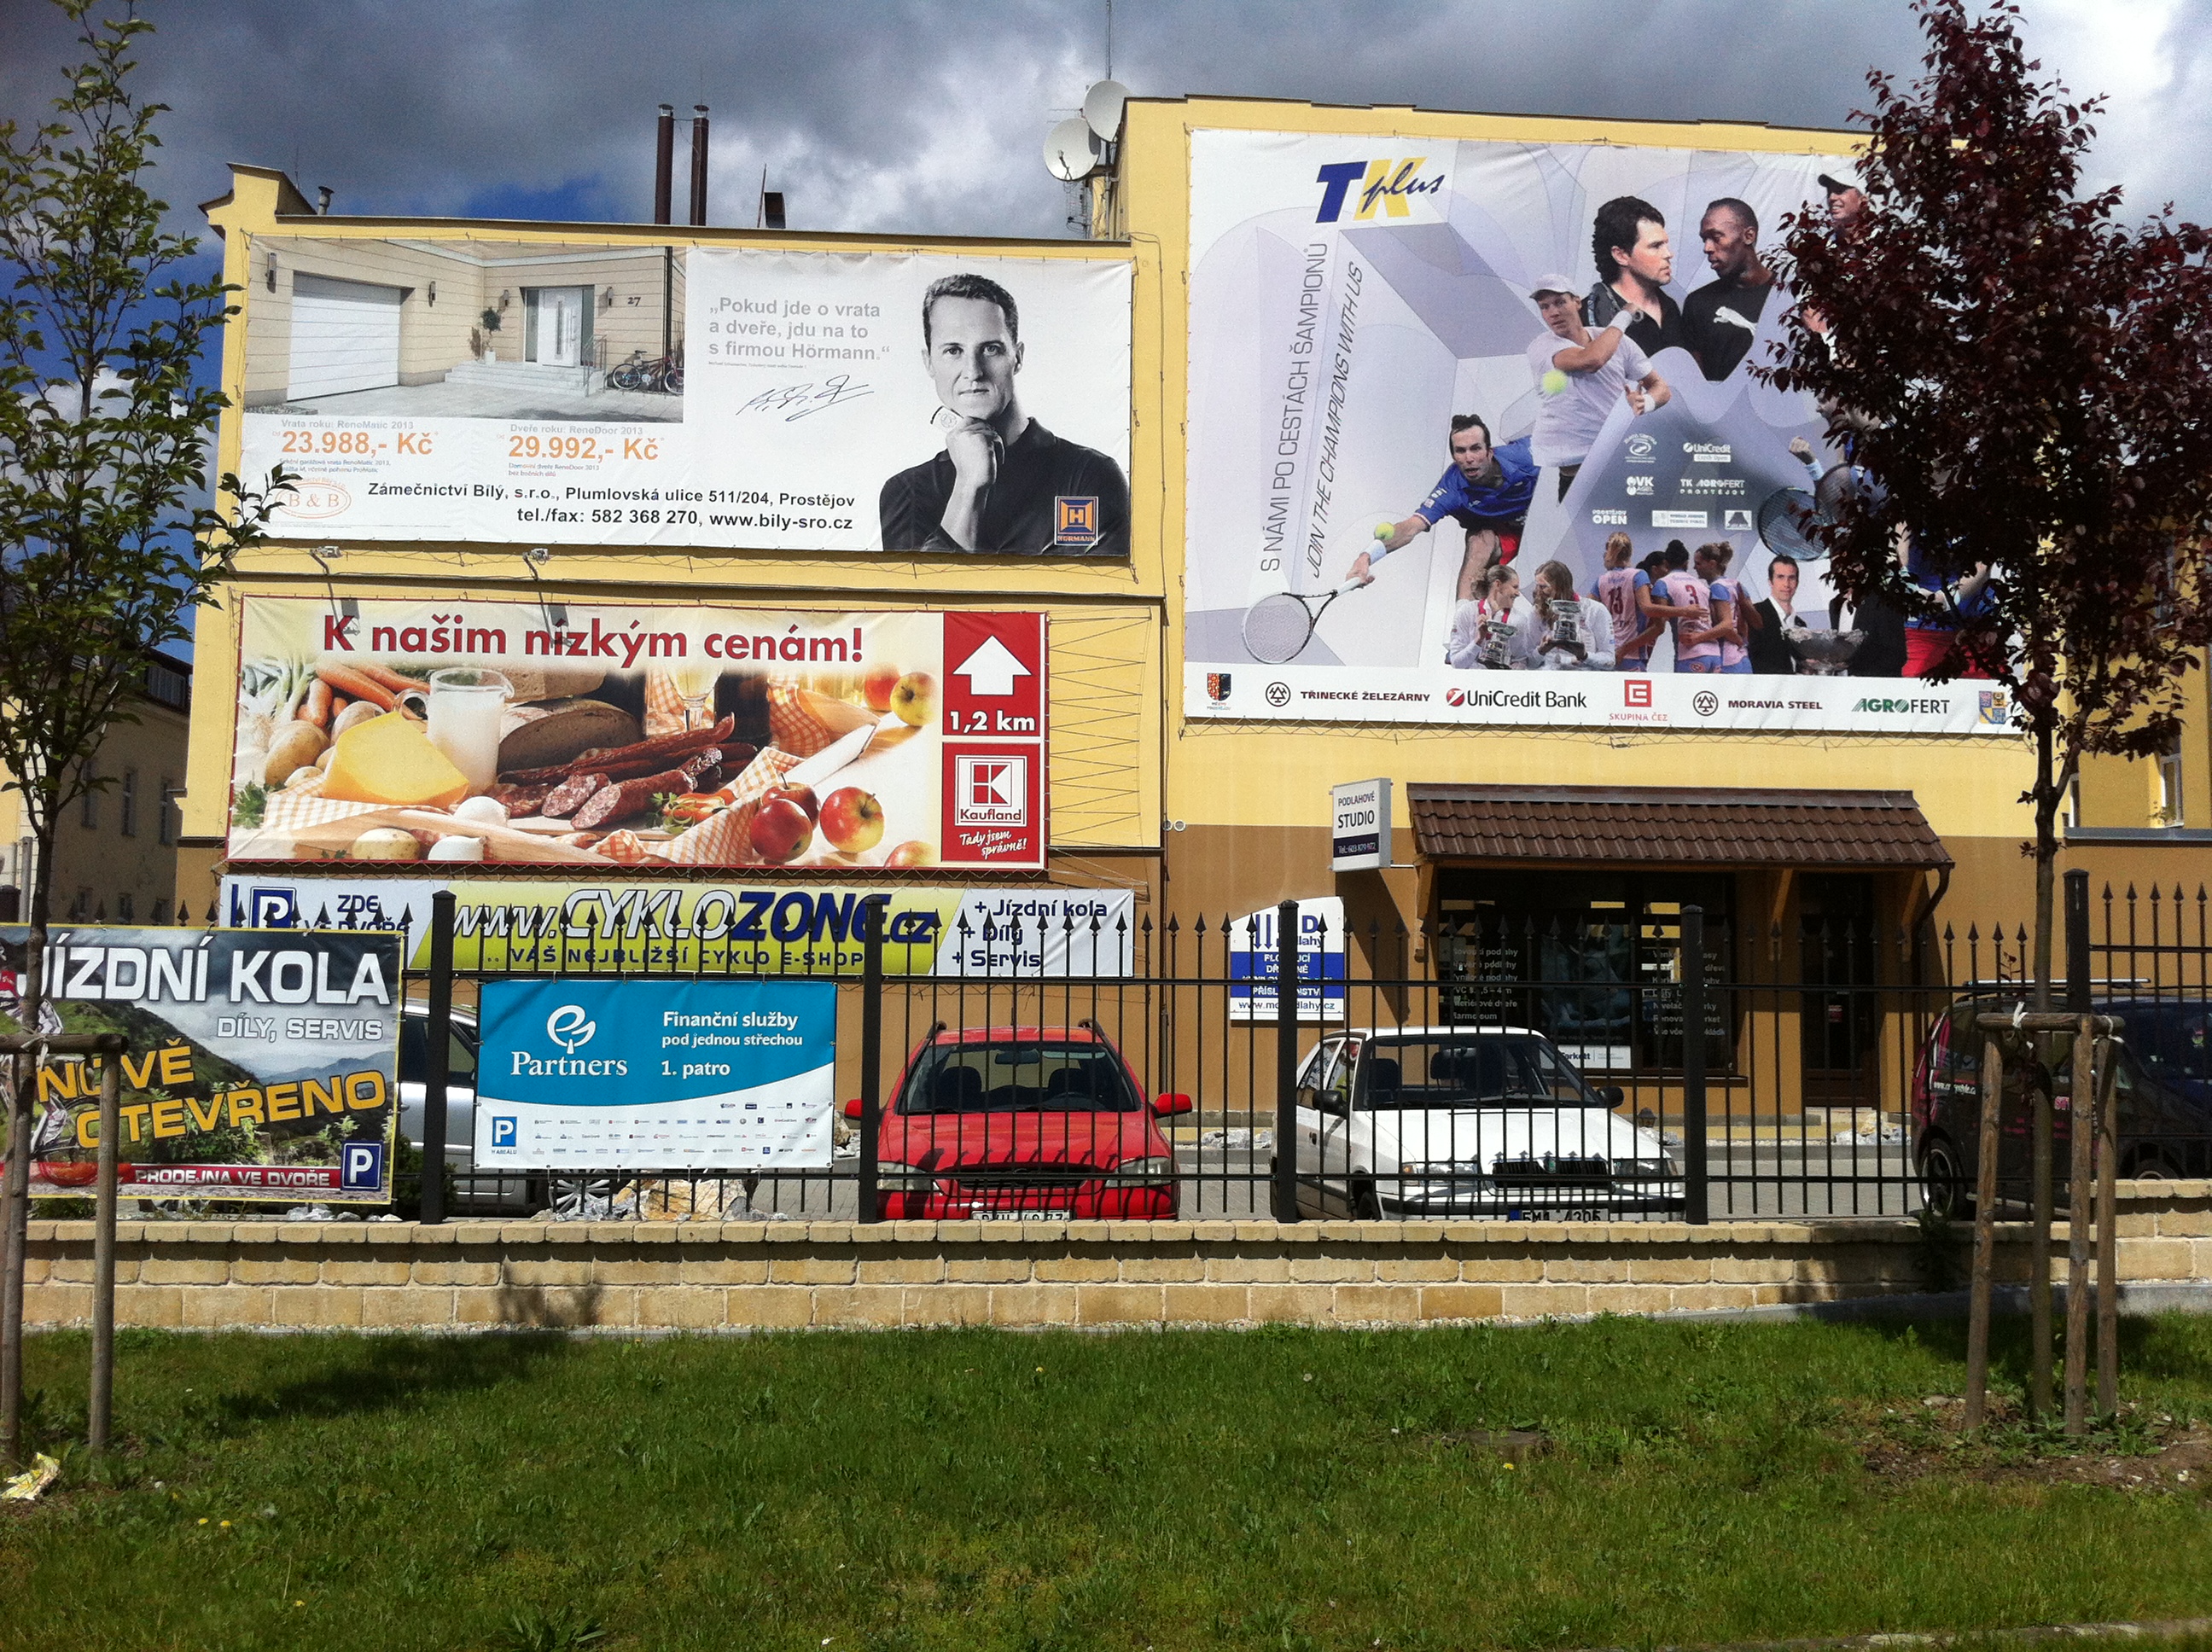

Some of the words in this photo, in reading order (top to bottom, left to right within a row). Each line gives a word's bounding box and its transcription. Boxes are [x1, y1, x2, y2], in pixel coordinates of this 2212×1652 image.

[1348, 261, 1363, 297] US
[627, 297, 641, 306] 27
[783, 300, 811, 317] jde
[818, 305, 829, 315] o
[835, 303, 881, 317] vrata
[1289, 243, 1328, 354] ŠAMPIONŮ
[709, 322, 719, 333] a
[726, 320, 782, 337] dveře,
[787, 322, 816, 340] jdu
[823, 326, 844, 337] na
[851, 325, 869, 338] to
[1337, 295, 1359, 353] WITH
[709, 344, 719, 355] s
[725, 341, 785, 357] firmou
[1278, 361, 1311, 456] CESTÁCH
[1320, 353, 1349, 483] CHAMPIONS
[282, 419, 306, 428] Vrata
[337, 420, 388, 429] RenoMatic
[510, 424, 538, 433] Dveře
[569, 426, 618, 435] RenoDoor
[620, 427, 643, 435] 2013
[282, 430, 387, 457] 23.988,-
[509, 435, 614, 463] 29.992,-
[1273, 462, 1295, 490] PO
[288, 494, 300, 507] B
[306, 493, 321, 508] &
[328, 494, 340, 508] B
[368, 482, 468, 497] Zámečnictví
[566, 487, 659, 501] Plumlovská
[665, 489, 703, 502] ulice
[708, 491, 774, 506] 511/204,
[779, 493, 855, 509] Prostějov
[1313, 480, 1331, 523] THE
[517, 508, 585, 522] tel./fax:
[591, 509, 623, 523] 582
[629, 510, 661, 524] 368
[667, 510, 703, 526] 270,
[709, 514, 853, 531] www.bily-sro.cz
[1069, 509, 1084, 523] H
[1263, 494, 1289, 552] NÁMI
[1592, 515, 1628, 525] OPEN
[1305, 525, 1325, 579] JOIN
[1261, 557, 1280, 572] S
[323, 614, 355, 651] K
[371, 614, 506, 655] našim
[525, 617, 687, 669] nízkým
[704, 624, 863, 662] cenám!
[1300, 689, 1359, 701] TŘINECKÉ
[1361, 690, 1431, 702] ŽELEZÁRNY
[1466, 689, 1541, 708] UniCredit
[1545, 691, 1587, 708] Bank
[1727, 700, 1784, 710] MORAVIA
[1788, 701, 1823, 710] STEEL
[1851, 698, 1950, 714] AGROFERT
[950, 710, 988, 733] 1,2
[996, 710, 1036, 731] km
[1610, 712, 1649, 722] SKUPINA
[1651, 711, 1668, 723] ČEZ
[960, 808, 1022, 821] Kaufland
[1337, 809, 1375, 829] STUDIO
[959, 833, 986, 846] Tady
[985, 829, 1012, 844] jsem
[992, 899, 1058, 917] Jízdní
[1063, 899, 1107, 917] kola
[230, 949, 391, 1005] KOLA
[217, 1012, 278, 1042] DÍLY,
[286, 1018, 383, 1041] SERVIS
[663, 1010, 739, 1027] Finanční
[742, 1011, 799, 1030] služby
[661, 1033, 690, 1047] pod
[692, 1033, 741, 1049] jednou
[743, 1033, 803, 1046] střechou
[510, 1050, 628, 1076] Partners
[661, 1060, 678, 1076] 1.
[682, 1061, 731, 1079] patro
[495, 1120, 514, 1143] P
[349, 1149, 374, 1184] P
[135, 1168, 231, 1185] PRODEJNA
[237, 1170, 261, 1185] VE
[267, 1169, 330, 1187] DVOŘE
